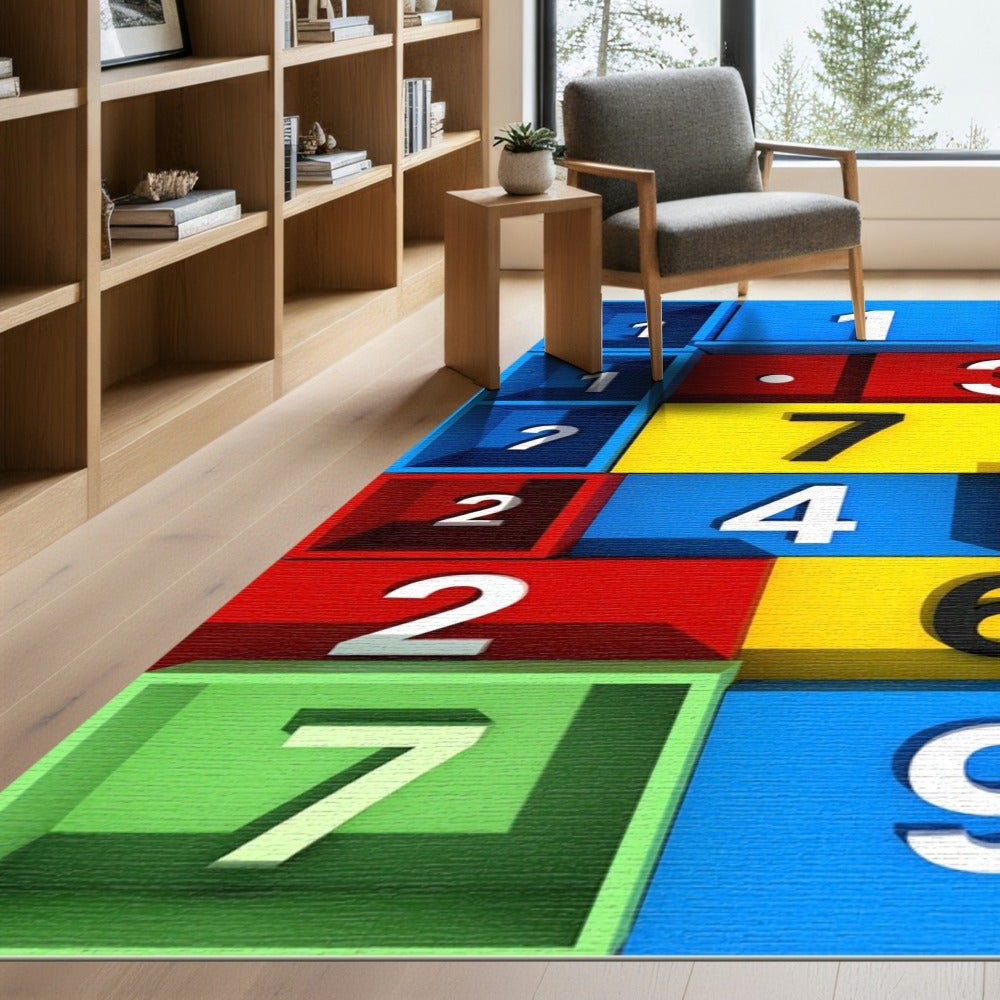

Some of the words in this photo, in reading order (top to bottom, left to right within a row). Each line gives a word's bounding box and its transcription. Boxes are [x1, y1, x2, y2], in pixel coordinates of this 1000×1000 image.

[838, 311, 895, 341] 1
[581, 372, 619, 392] 1
[790, 414, 905, 461] 7
[433, 494, 523, 526] 2
[720, 485, 857, 544] 4
[329, 574, 529, 656] 2
[215, 725, 488, 868] 7
